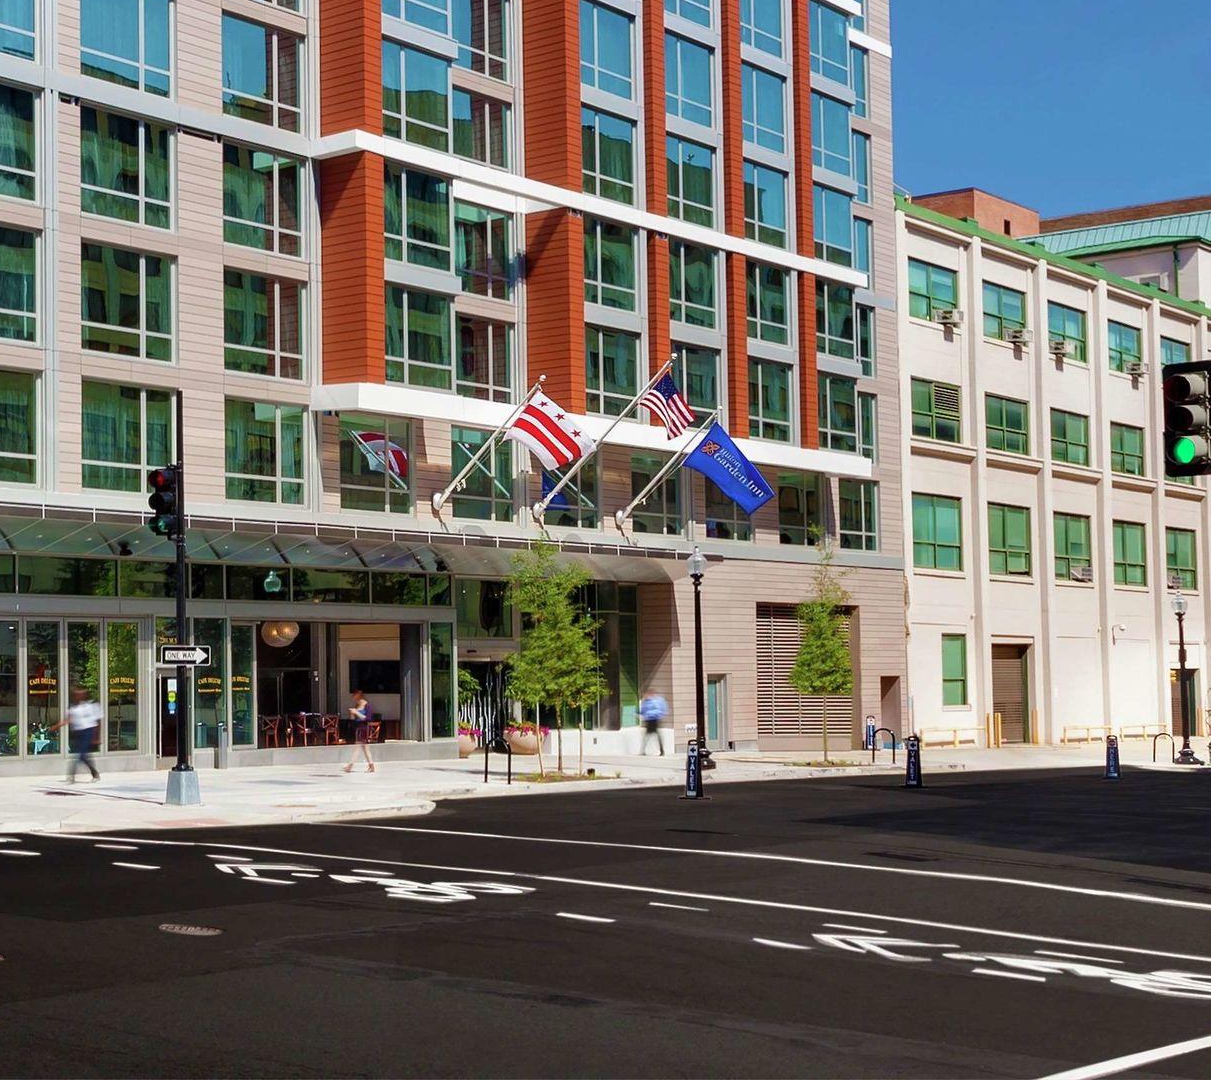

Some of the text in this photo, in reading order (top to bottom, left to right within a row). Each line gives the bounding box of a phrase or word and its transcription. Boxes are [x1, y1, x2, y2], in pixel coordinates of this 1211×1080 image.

[713, 452, 765, 498] Garden Inn
[167, 651, 196, 660] ONE WAY
